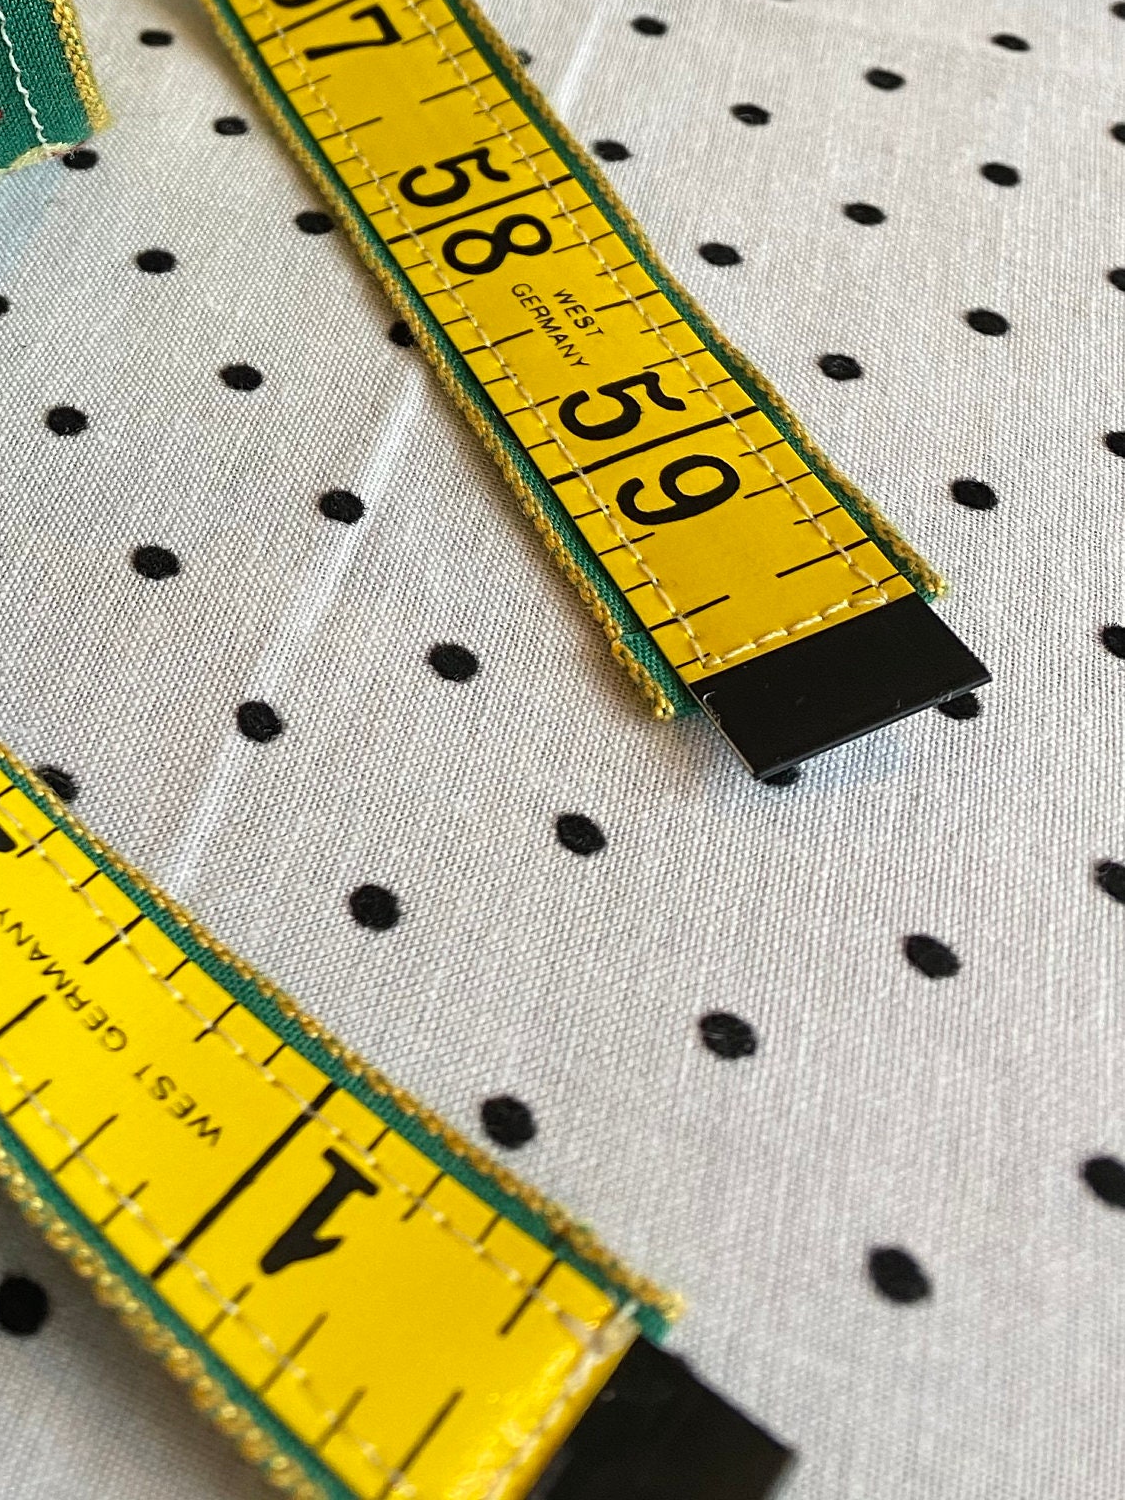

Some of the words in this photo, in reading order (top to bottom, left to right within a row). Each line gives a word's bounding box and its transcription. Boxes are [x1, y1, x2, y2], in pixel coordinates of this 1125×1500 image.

[399, 148, 552, 274] 58
[511, 282, 592, 368] GERMANY
[554, 288, 604, 338] WEST
[558, 370, 741, 525] 59
[132, 1066, 226, 1147] WEST
[259, 1147, 379, 1275] 1
